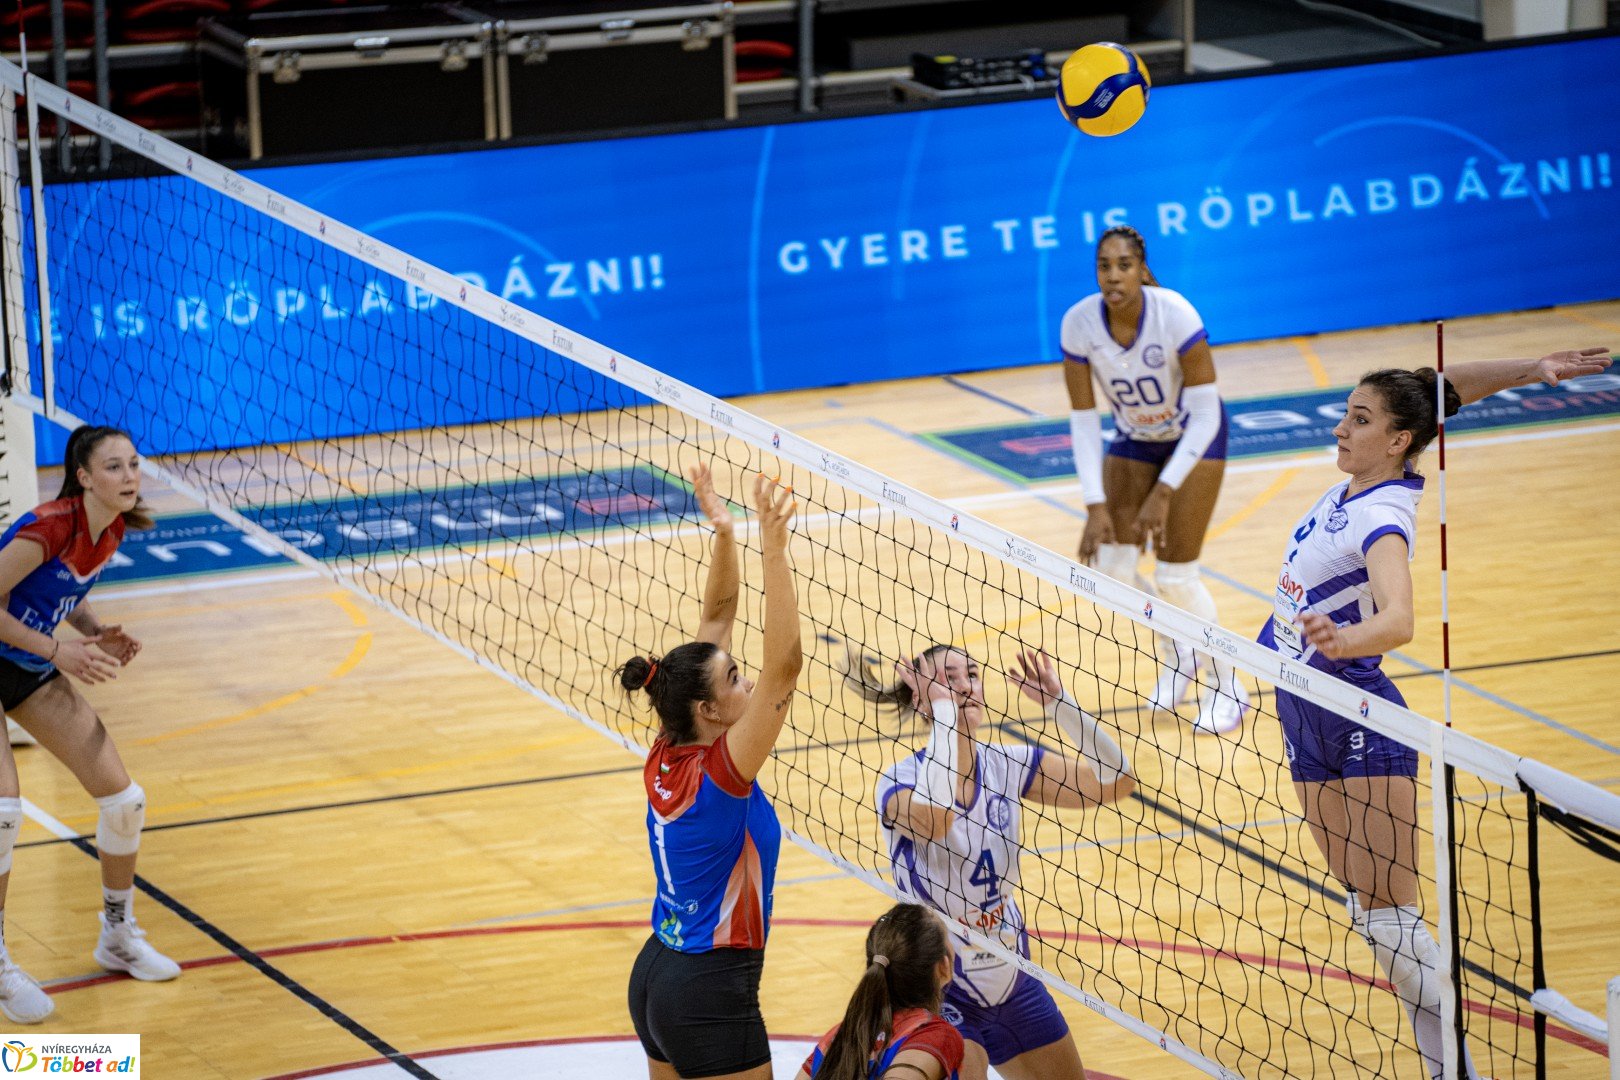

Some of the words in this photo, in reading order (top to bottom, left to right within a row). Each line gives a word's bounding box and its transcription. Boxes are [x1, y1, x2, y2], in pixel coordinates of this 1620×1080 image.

[778, 224, 969, 274] GYERE
[993, 215, 1060, 253] TE
[1157, 152, 1612, 236] RÖPLABDÁZNI!
[91, 299, 145, 341] IS
[1111, 376, 1165, 407] 20
[710, 402, 734, 427] FATUM
[882, 481, 908, 506] FATUM
[1069, 566, 1097, 595] FATUM
[1279, 661, 1312, 692] FATUM
[653, 822, 676, 896] 1
[969, 848, 1000, 898] 4
